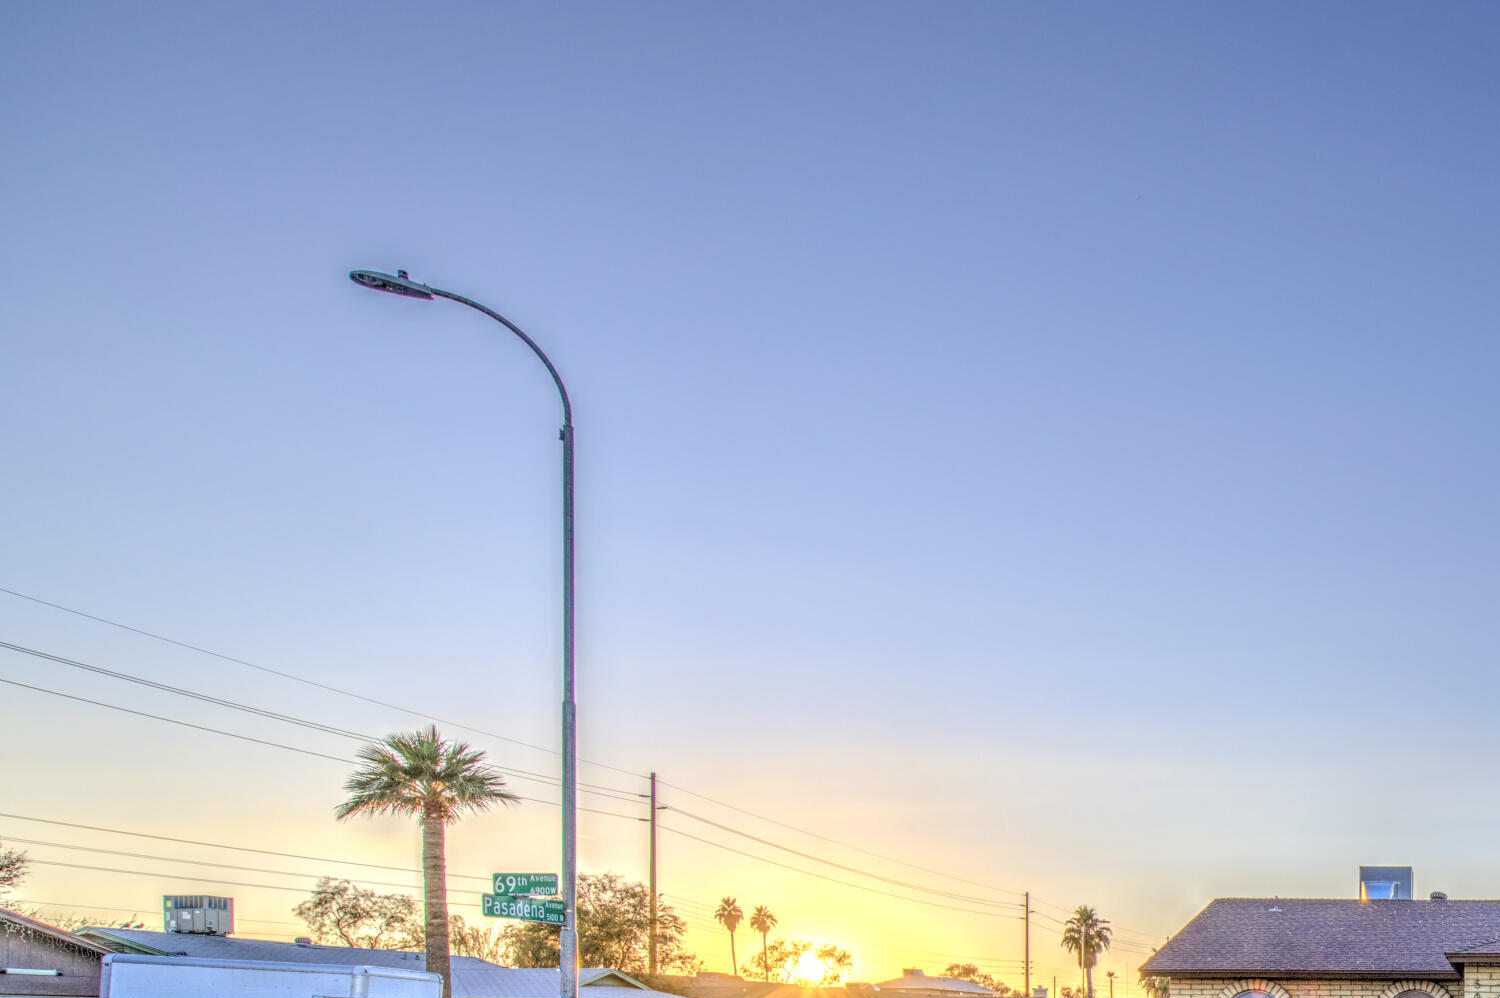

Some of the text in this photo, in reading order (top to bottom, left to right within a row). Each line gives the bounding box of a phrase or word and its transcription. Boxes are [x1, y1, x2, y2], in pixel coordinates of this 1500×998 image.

[494, 874, 556, 893] 69th Avenue
[484, 897, 564, 918] Pasadena Avenue
